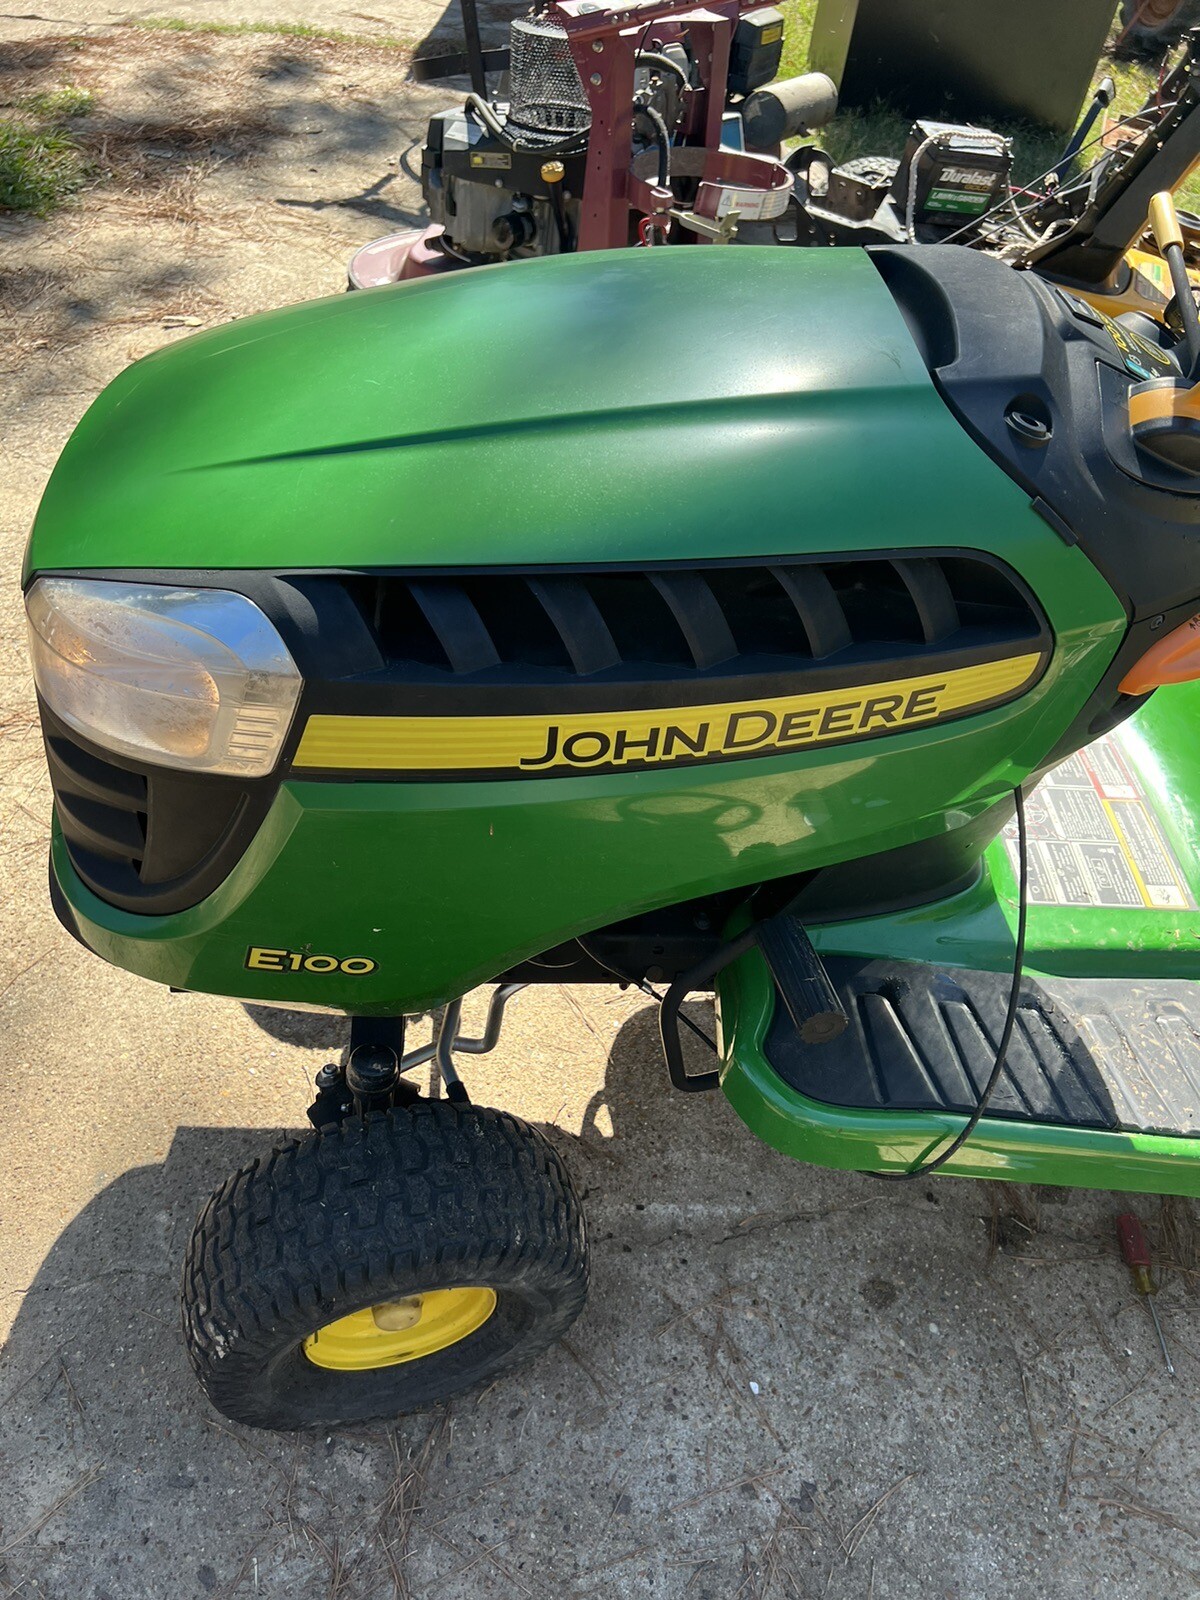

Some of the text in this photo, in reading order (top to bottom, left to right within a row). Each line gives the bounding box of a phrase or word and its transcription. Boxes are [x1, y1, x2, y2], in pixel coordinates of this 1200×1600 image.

[939, 167, 997, 187] Duralast
[519, 683, 947, 766] JOHN DEERE
[247, 947, 376, 975] E100
